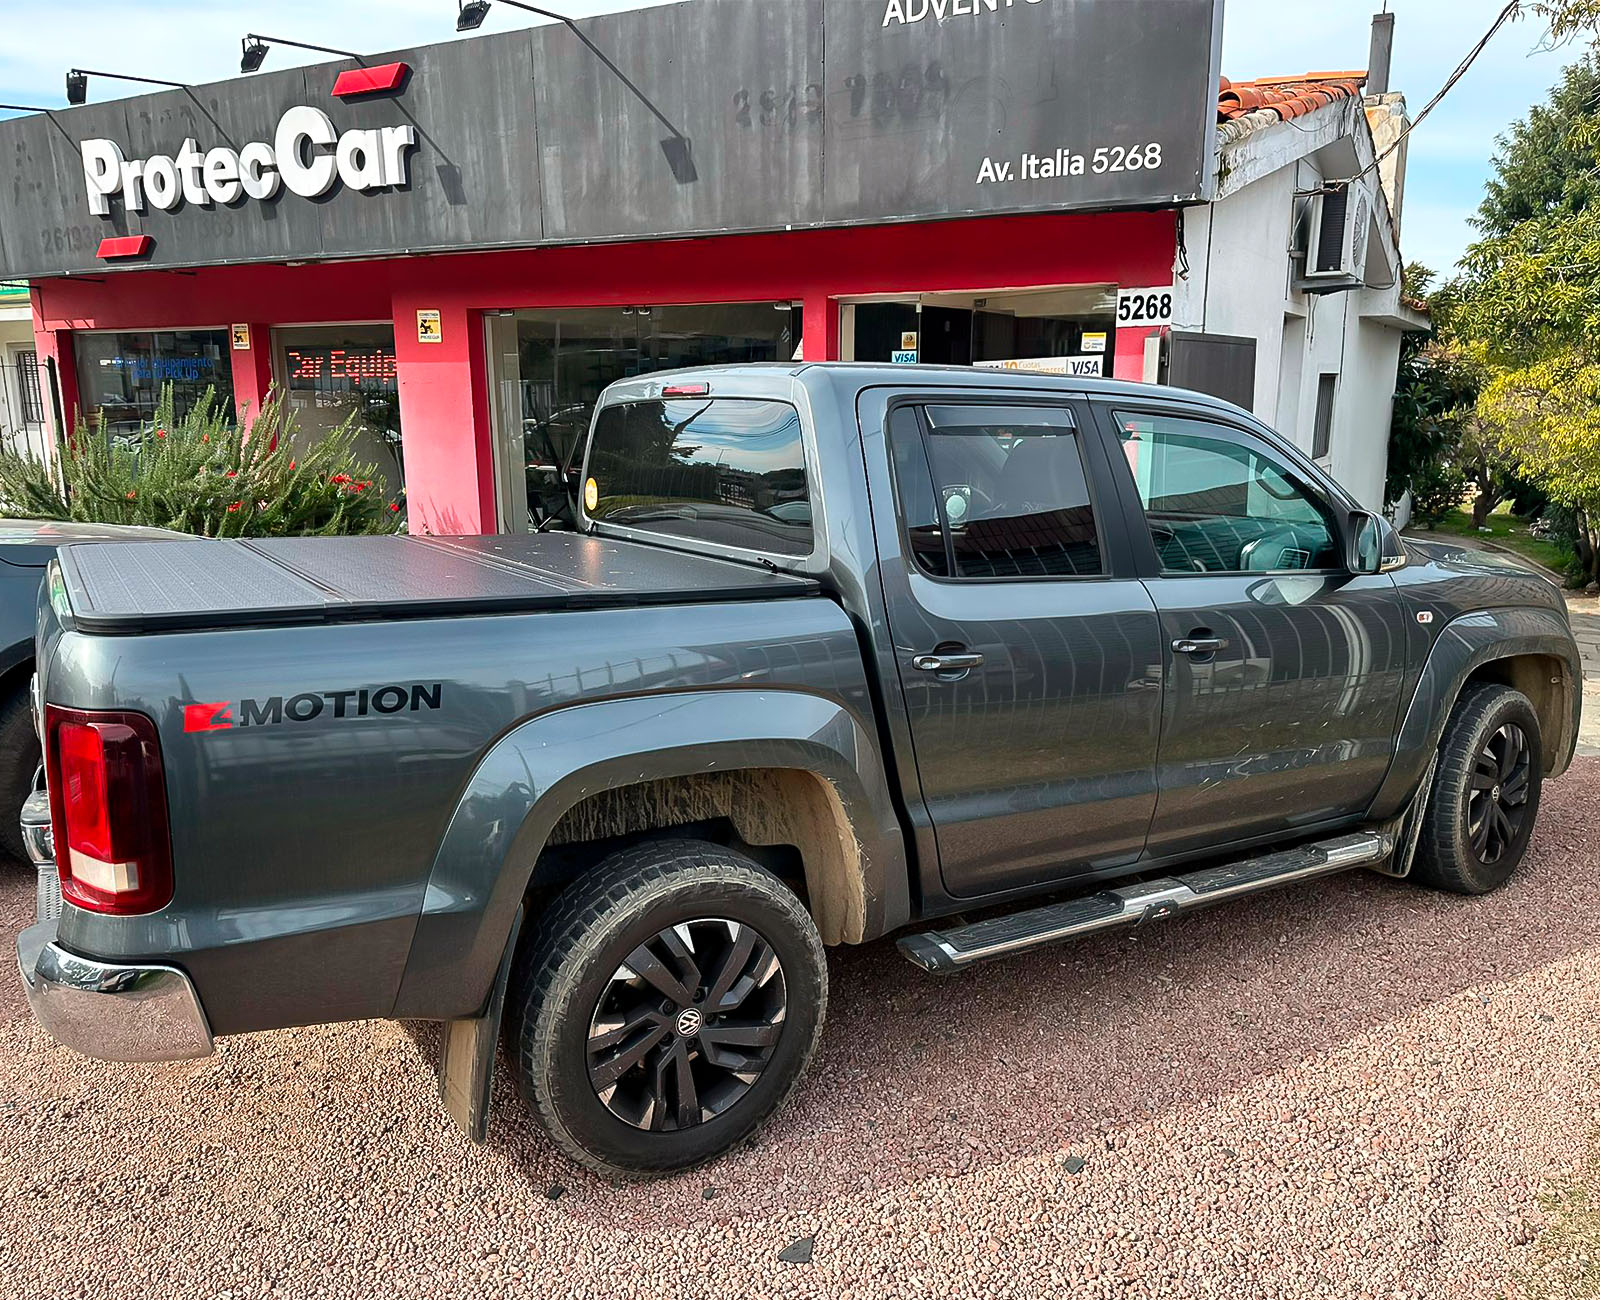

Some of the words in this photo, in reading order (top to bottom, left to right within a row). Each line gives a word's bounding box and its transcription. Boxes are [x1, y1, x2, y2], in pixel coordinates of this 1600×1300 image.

[80, 105, 415, 216] ProtecCar
[975, 156, 1014, 184] Av.
[1021, 148, 1085, 180] Italia
[1091, 142, 1163, 174] 5268
[1118, 293, 1172, 321] 5268
[894, 353, 916, 363] VISA
[1071, 360, 1099, 375] VISA
